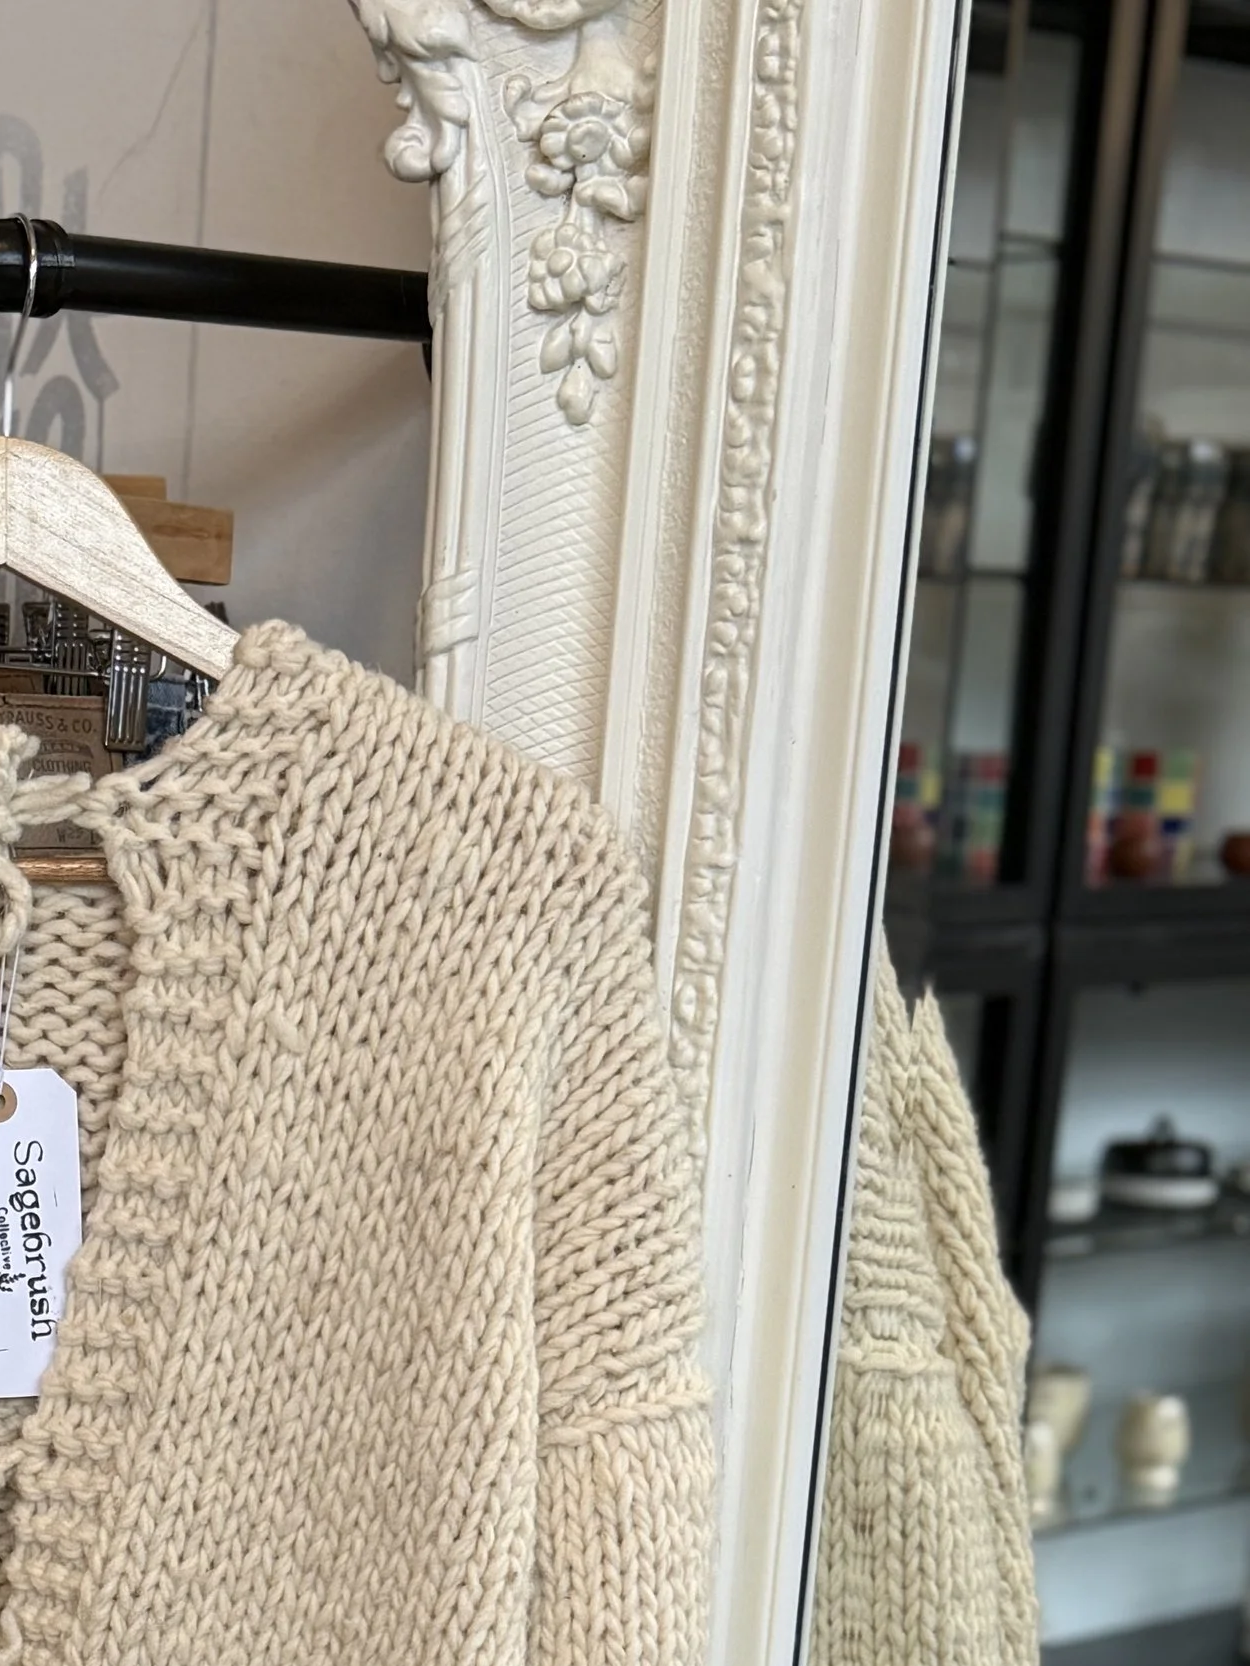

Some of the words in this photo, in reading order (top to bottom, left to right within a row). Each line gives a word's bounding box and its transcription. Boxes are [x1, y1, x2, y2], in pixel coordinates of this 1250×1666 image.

[57, 718, 69, 732] &
[71, 718, 98, 734] CO.
[33, 758, 92, 773] CLOTHING
[8, 1140, 57, 1341] Sagebrush
